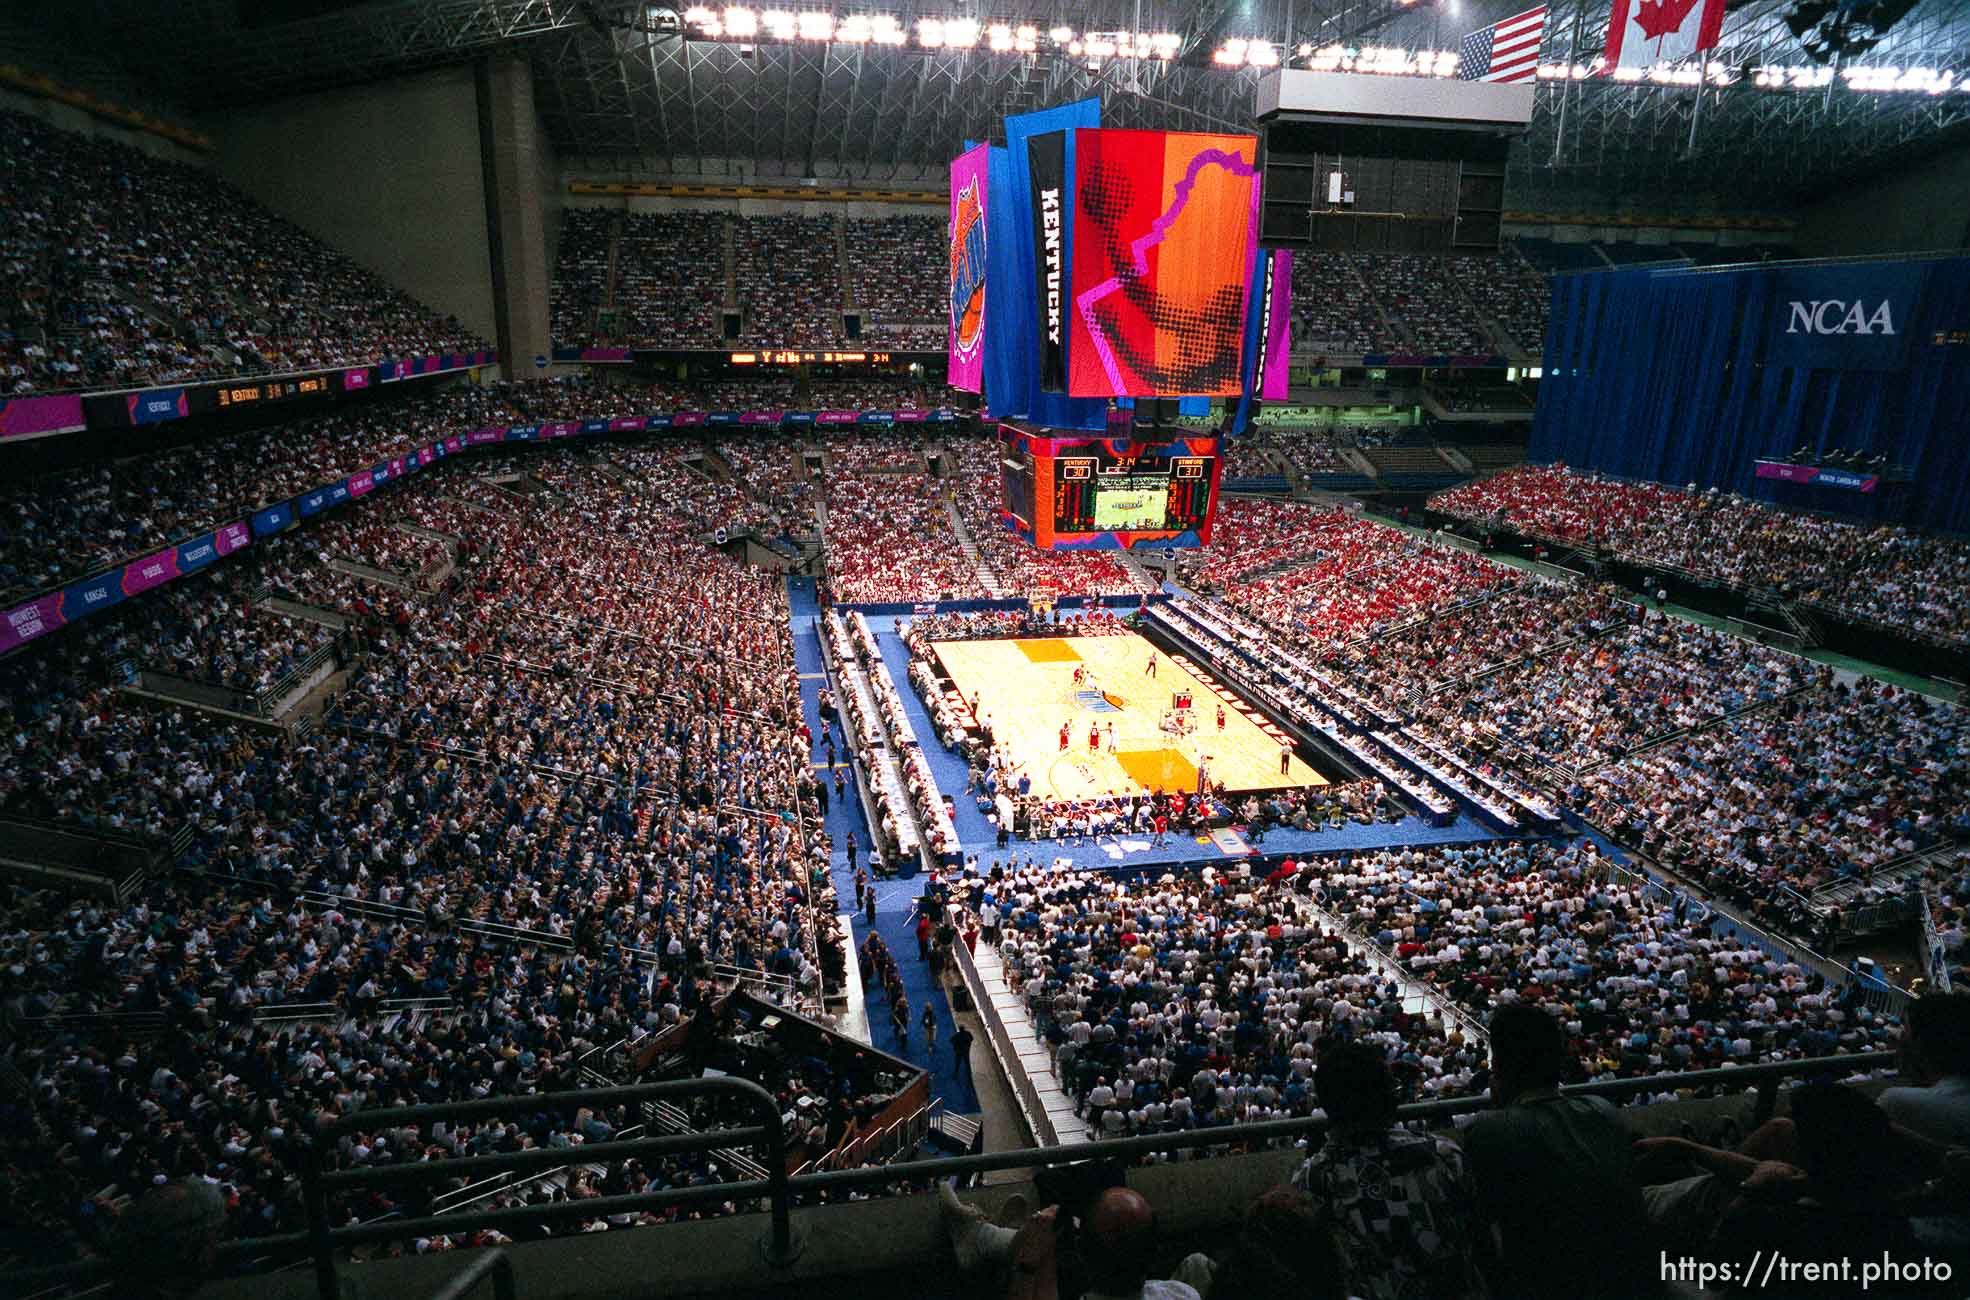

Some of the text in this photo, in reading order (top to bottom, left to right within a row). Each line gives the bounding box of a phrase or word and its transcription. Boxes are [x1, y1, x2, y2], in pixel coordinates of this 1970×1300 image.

[1041, 187, 1060, 345] KENTUCKY
[1785, 299, 1895, 336] NCAA
[1072, 468, 1085, 476] 30
[1116, 457, 1137, 466] 3:14
[1185, 467, 1197, 476] 31
[945, 689, 979, 727] NCAA
[1170, 655, 1298, 746] SAN ANTONIO
[1253, 685, 1269, 703] FINAL
[1267, 696, 1282, 713] FOUR
